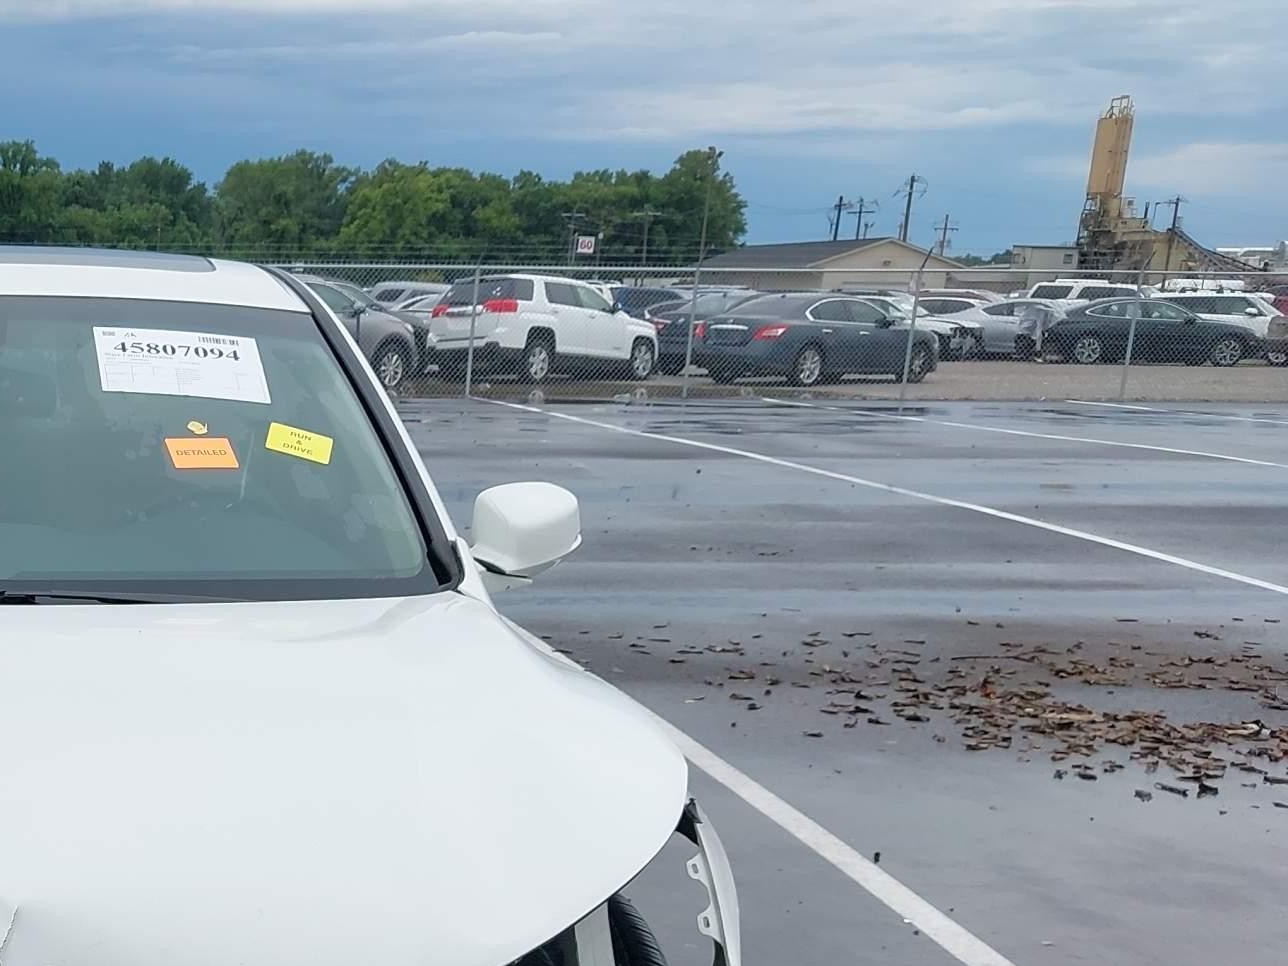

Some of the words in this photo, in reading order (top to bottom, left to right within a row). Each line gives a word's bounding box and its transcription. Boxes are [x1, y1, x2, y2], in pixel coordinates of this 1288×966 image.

[114, 341, 240, 361] 45807094
[290, 431, 312, 442] RUN
[176, 449, 228, 457] DETAILED
[282, 442, 313, 456] DRIVE
